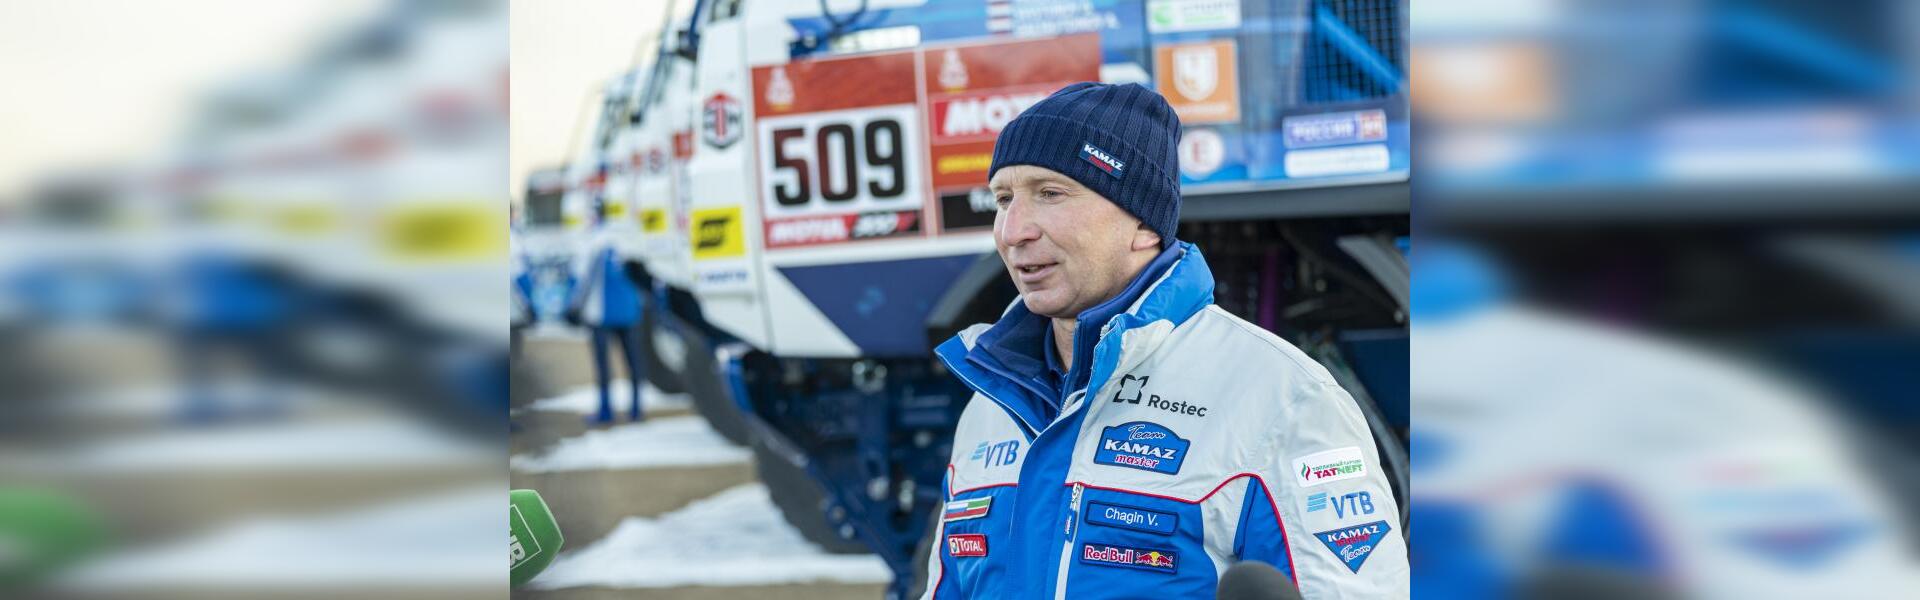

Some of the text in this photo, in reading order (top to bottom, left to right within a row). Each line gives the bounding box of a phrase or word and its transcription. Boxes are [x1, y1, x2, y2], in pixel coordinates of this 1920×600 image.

[773, 119, 906, 206] 509
[1083, 143, 1124, 171] KAMAZ
[1147, 394, 1208, 418] Rostec
[1127, 424, 1167, 441] Team
[984, 440, 1020, 469] VTB
[1104, 439, 1177, 460] KAMAZ
[1115, 454, 1160, 469] master
[1314, 464, 1363, 479] TATNEFT
[1331, 491, 1375, 519] VTB
[1105, 507, 1144, 525] Chagin
[1327, 525, 1380, 542] KAMAZ
[958, 538, 983, 552] TOTAL
[1341, 544, 1371, 562] Team
[1084, 545, 1134, 564] Red Bull
